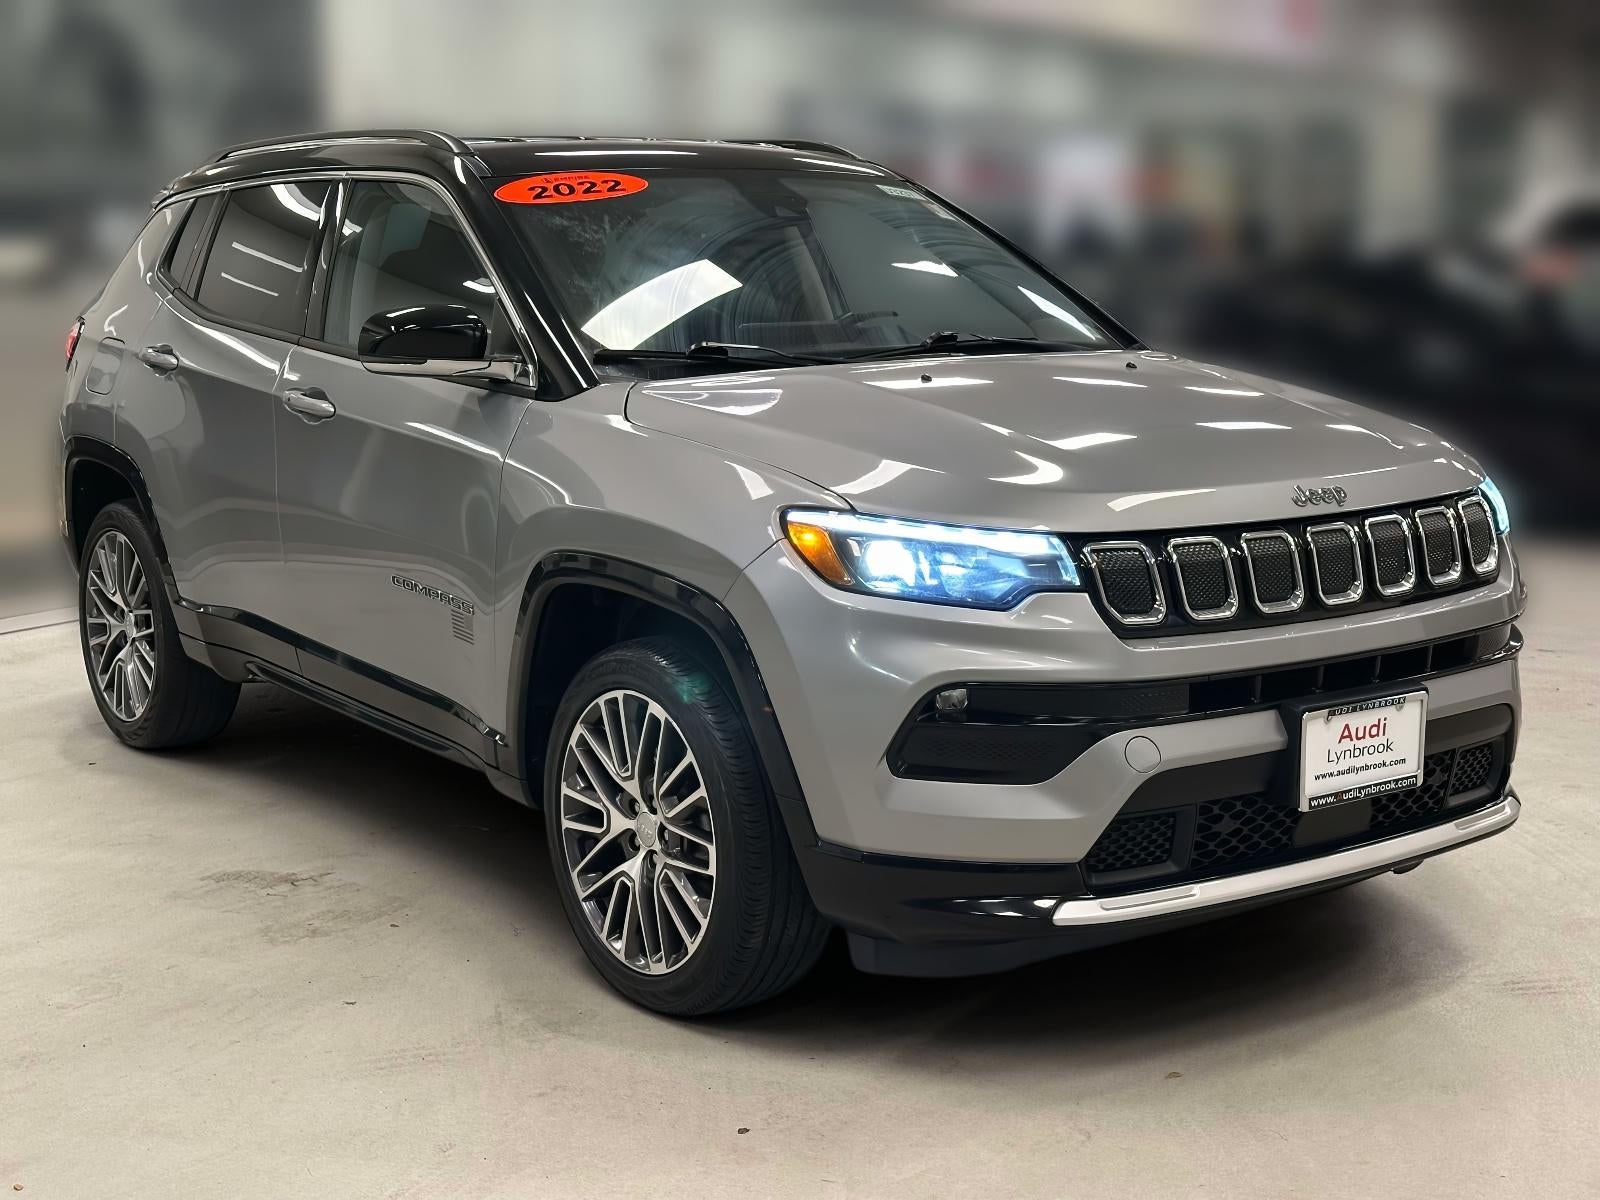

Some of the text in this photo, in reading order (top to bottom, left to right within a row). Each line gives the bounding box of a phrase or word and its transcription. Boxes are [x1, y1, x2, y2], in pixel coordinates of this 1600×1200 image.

[527, 178, 627, 202] 2022
[1291, 481, 1348, 507] Jeep
[390, 573, 475, 616] COMPASS
[1356, 696, 1407, 713] LYNBROOK
[1338, 717, 1388, 744] Audi
[1327, 738, 1394, 765] Lynbrook
[1314, 757, 1407, 781] www.audilynbrook.com
[1310, 777, 1417, 807] www.AudiLynbrook.com
